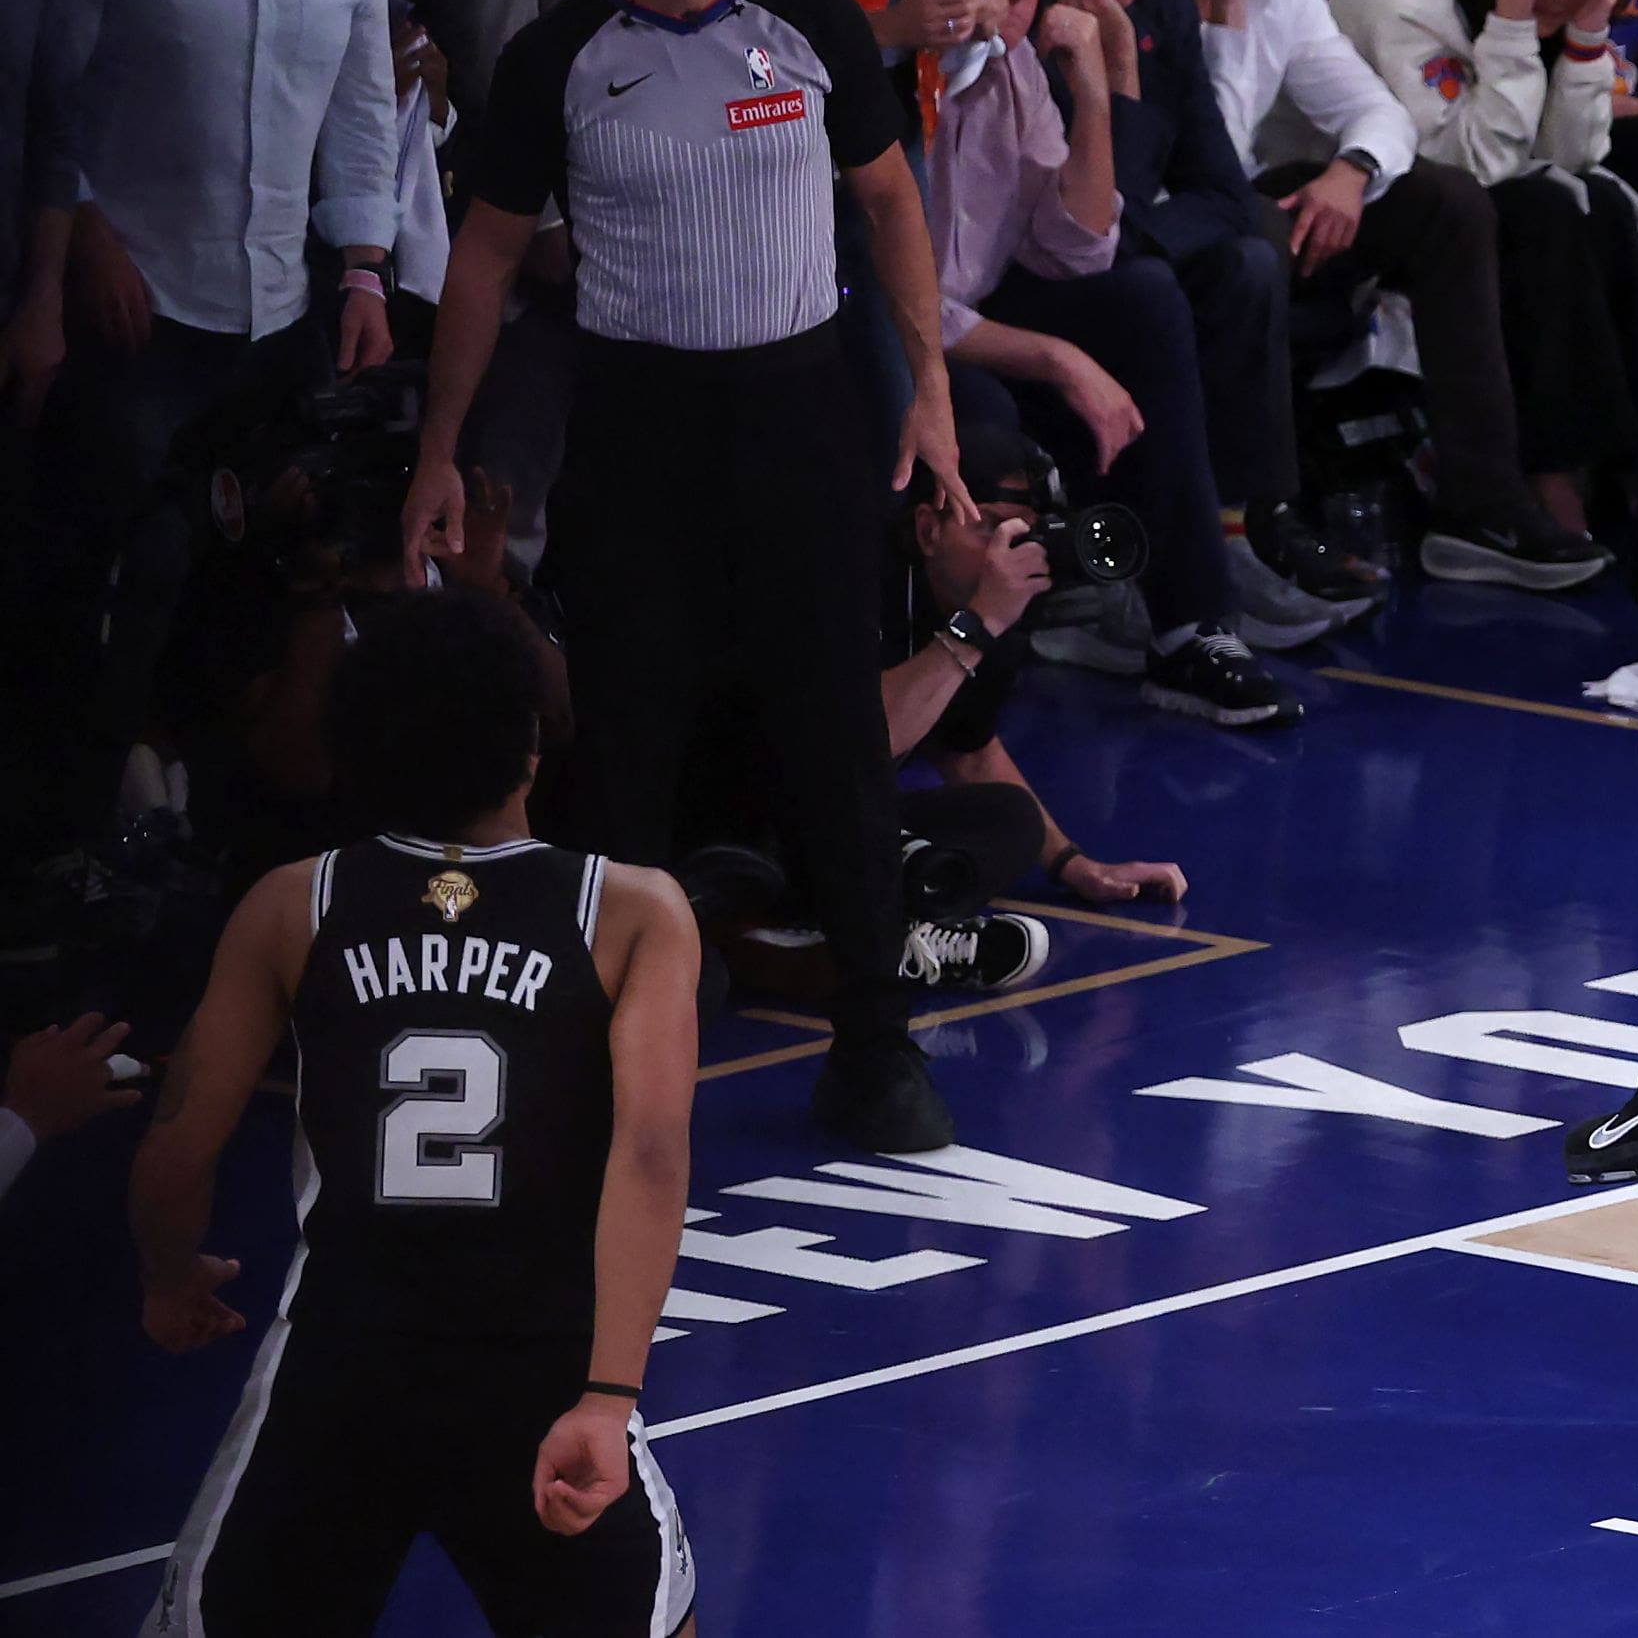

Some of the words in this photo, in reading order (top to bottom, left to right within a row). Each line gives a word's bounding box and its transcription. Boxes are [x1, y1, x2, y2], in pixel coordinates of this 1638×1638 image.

[729, 98, 803, 124] Emirates
[433, 878, 475, 899] Finals
[343, 933, 554, 1012] HARPER
[374, 1027, 508, 1208] 2
